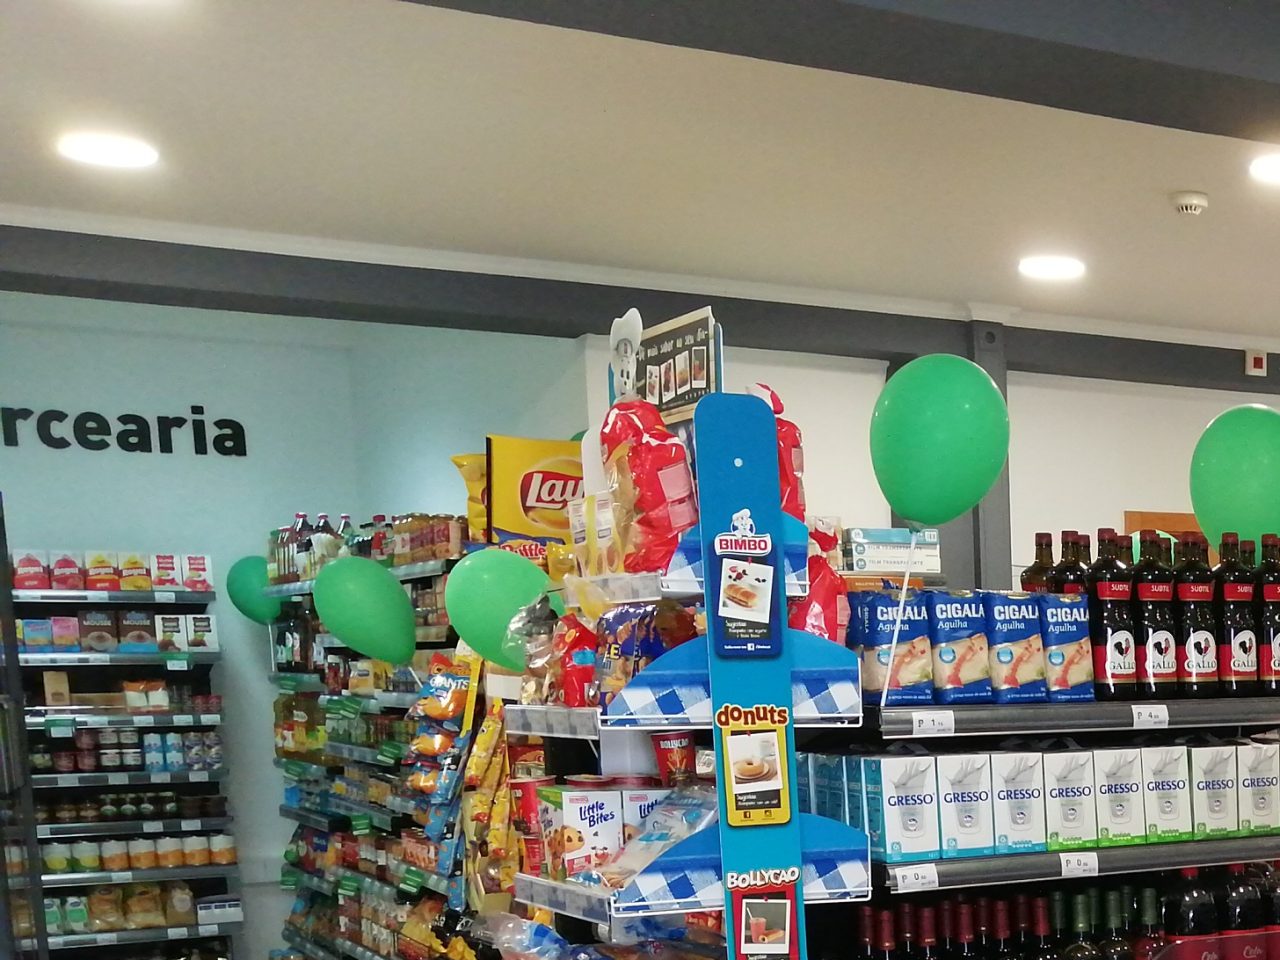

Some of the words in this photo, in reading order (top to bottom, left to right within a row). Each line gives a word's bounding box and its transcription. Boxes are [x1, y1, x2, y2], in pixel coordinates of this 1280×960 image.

[1, 405, 247, 457] rcearia
[719, 538, 768, 551] BIMBO
[935, 603, 986, 619] CIGALA
[993, 604, 1040, 620] CIGALA
[1047, 607, 1090, 623] CIGALA
[937, 620, 968, 631] Agulha
[995, 621, 1025, 632] Agulha
[1048, 623, 1077, 633] Agulha
[1187, 658, 1217, 669] GALLO
[716, 704, 788, 727] donuts
[1099, 782, 1139, 795] GRESSO
[1147, 780, 1186, 793] GRESSO
[1196, 778, 1234, 792] GRESSO
[1242, 776, 1278, 789] GRESSO
[943, 790, 989, 804] GRESSO
[997, 788, 1041, 801] GRESSO
[1049, 785, 1092, 799] GRESSO
[887, 793, 934, 807] GRESSO
[579, 801, 605, 821] Little
[588, 811, 615, 828] Bites
[727, 867, 799, 888] BOLLYCAO
